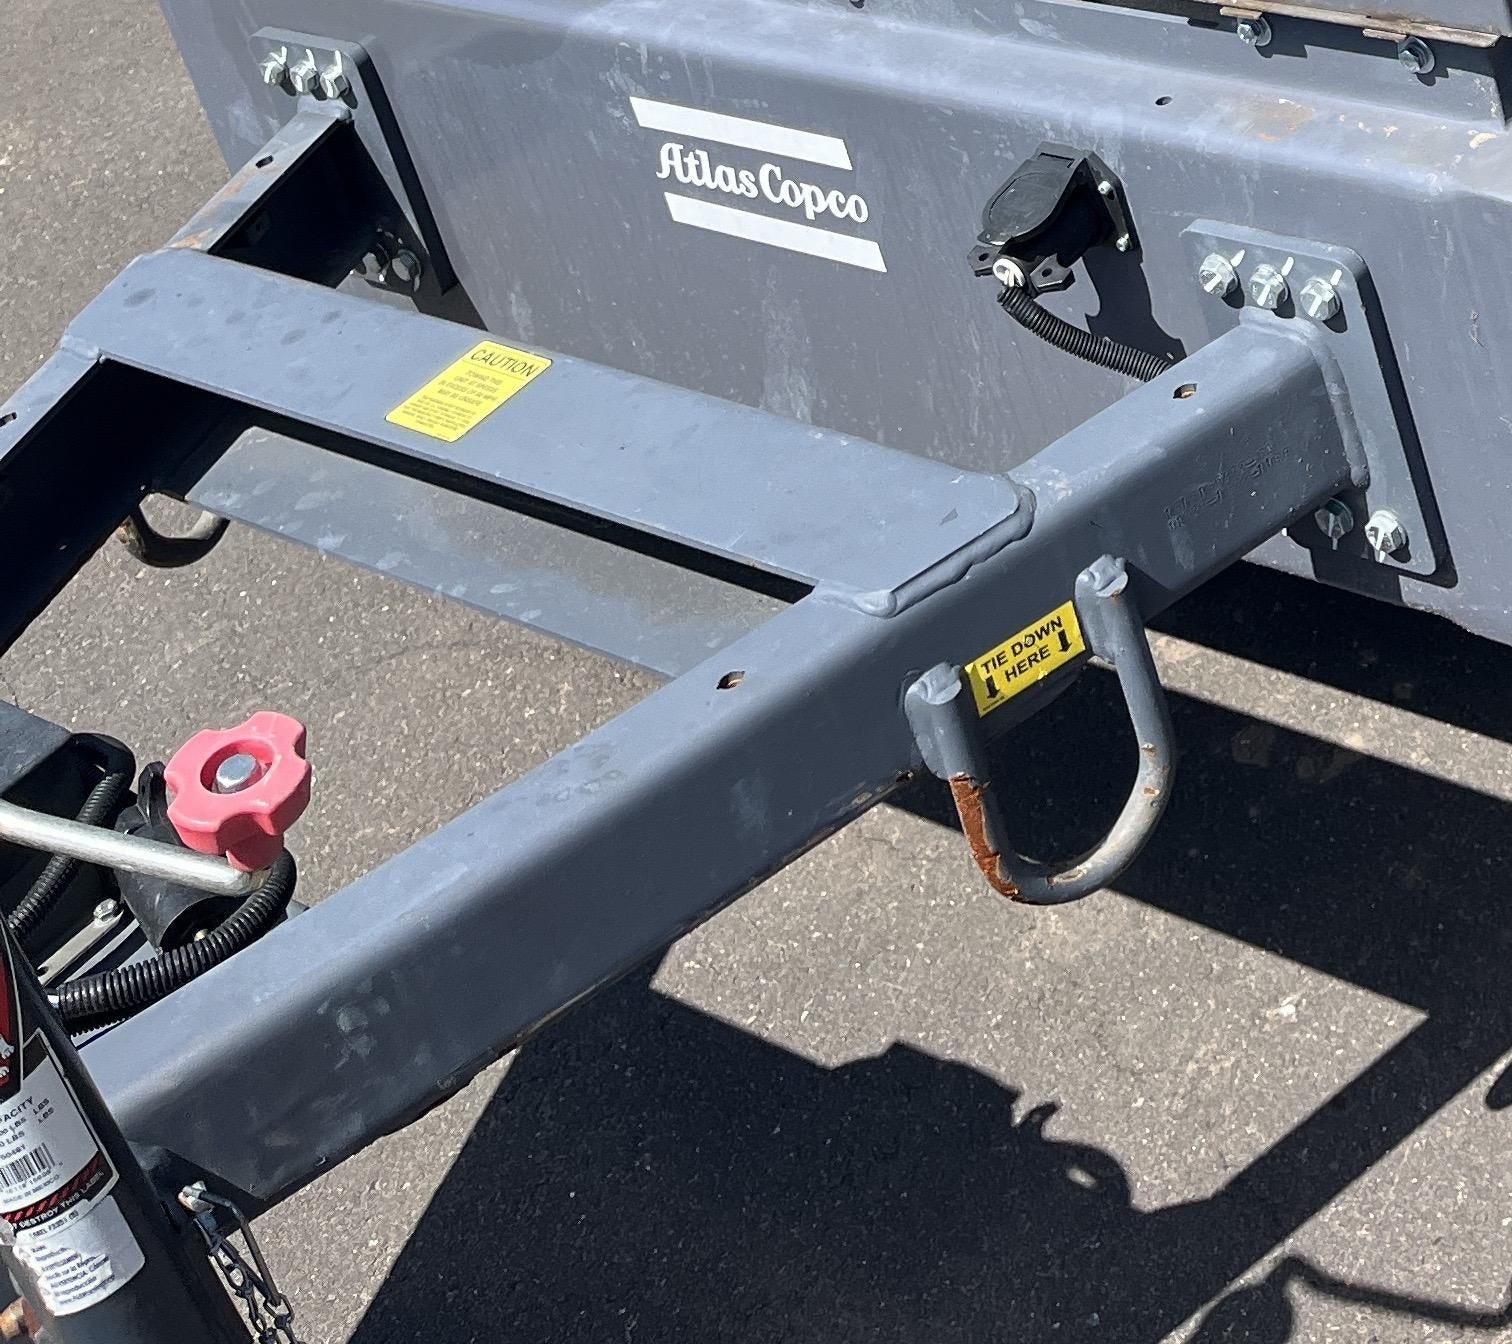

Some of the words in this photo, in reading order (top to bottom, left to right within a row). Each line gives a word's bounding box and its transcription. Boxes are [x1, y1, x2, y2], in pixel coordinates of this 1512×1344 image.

[470, 348, 540, 378] CAUTION
[980, 650, 1009, 675] TIE
[1010, 615, 1063, 658] DOWN
[1004, 644, 1051, 683] HERE
[0, 1096, 34, 1124] ACITY
[20, 1207, 59, 1229] DESTROY
